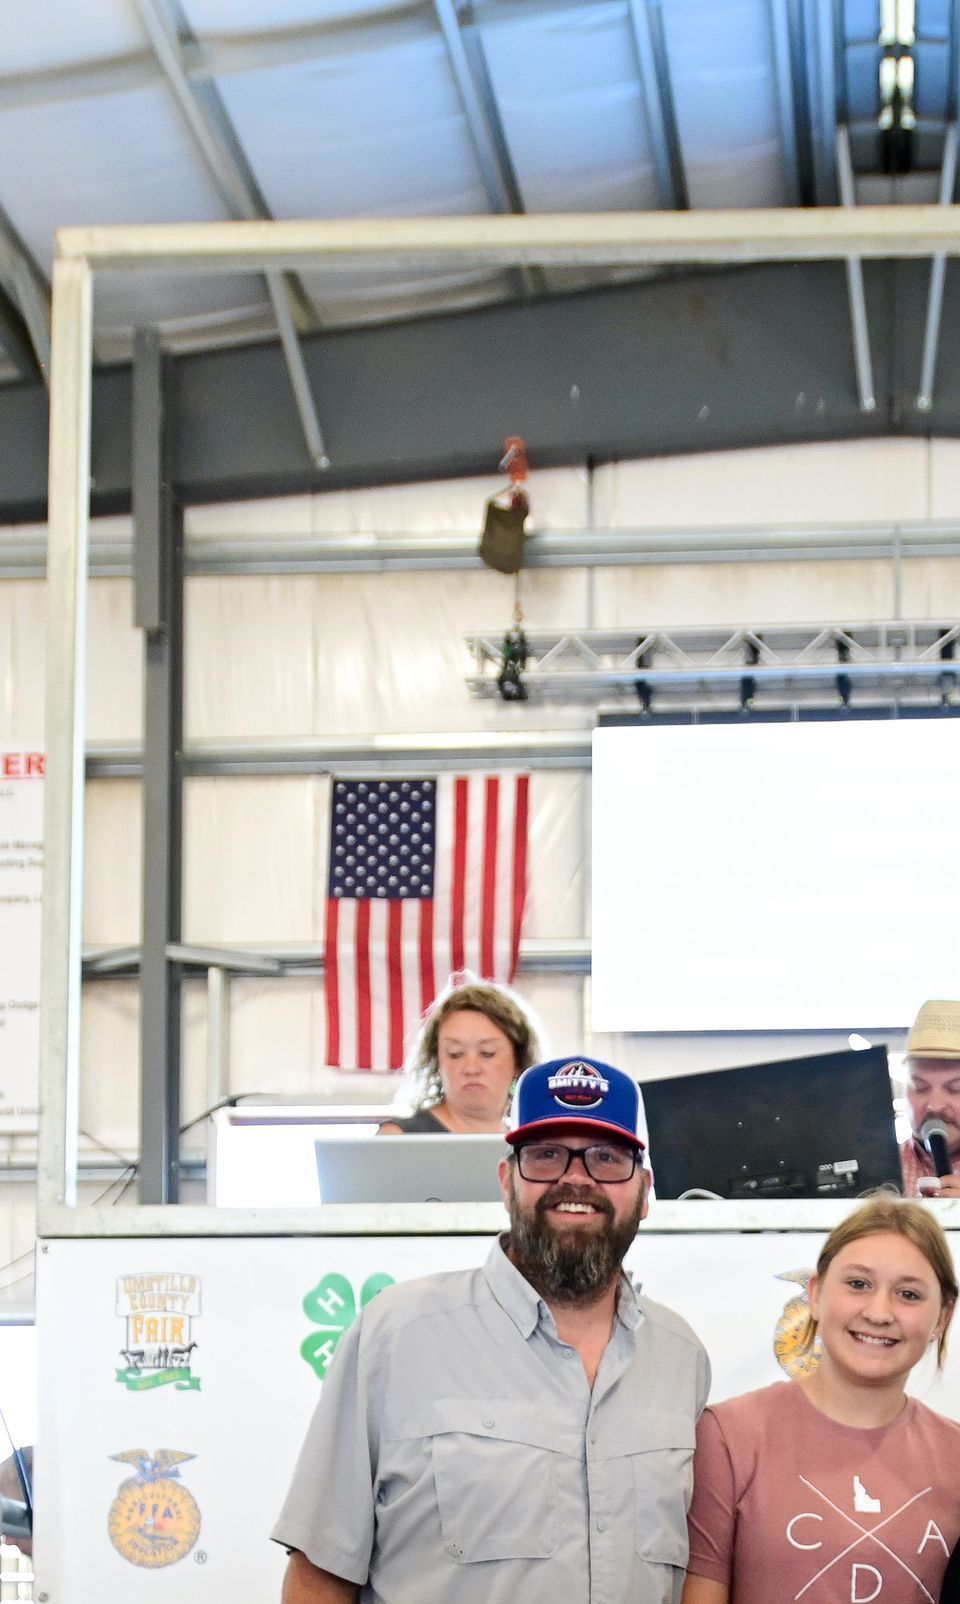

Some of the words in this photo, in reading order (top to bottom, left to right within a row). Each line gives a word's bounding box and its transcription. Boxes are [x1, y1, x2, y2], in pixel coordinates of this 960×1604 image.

[548, 1078, 610, 1093] SMITTY'S
[131, 1314, 185, 1344] FAIR
[786, 1513, 824, 1550] C
[917, 1519, 950, 1557] A
[851, 1563, 883, 1603] D
